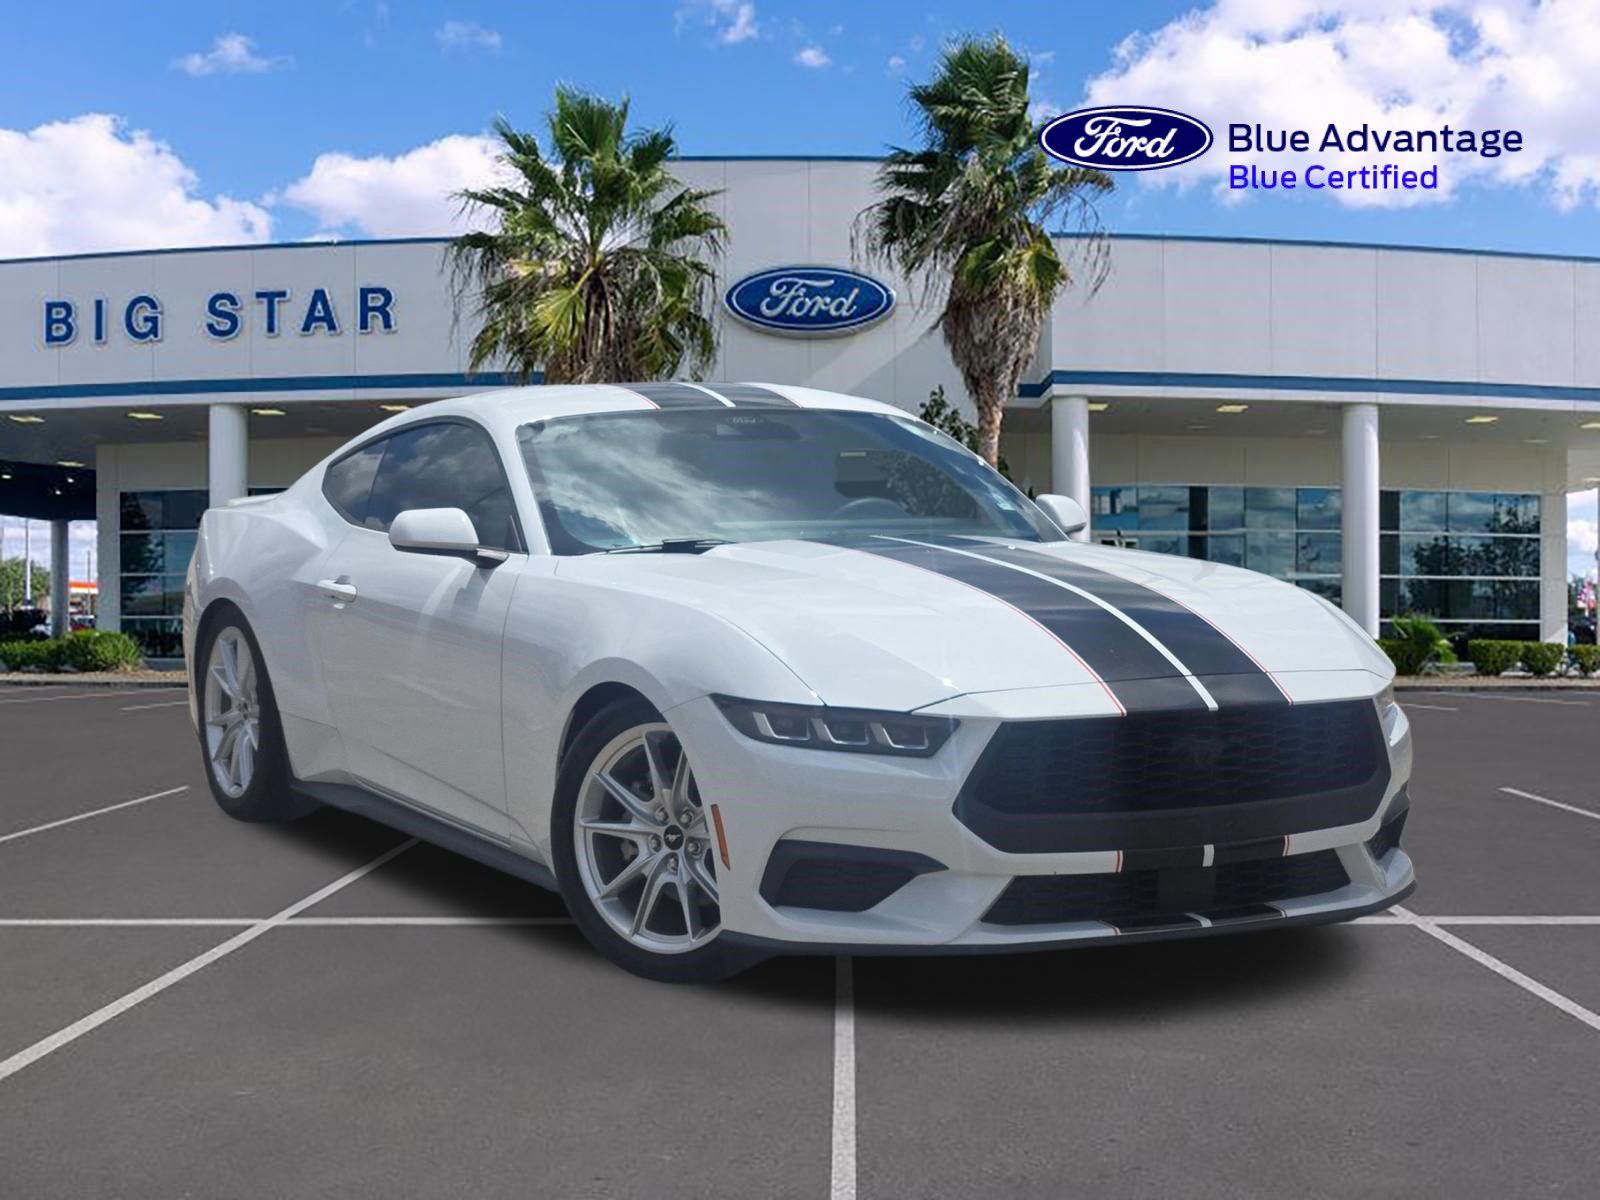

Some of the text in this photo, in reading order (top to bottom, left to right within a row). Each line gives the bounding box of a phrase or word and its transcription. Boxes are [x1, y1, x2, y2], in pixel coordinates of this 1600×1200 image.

[44, 287, 394, 345] BIG STAR
[759, 277, 860, 318] Ford
